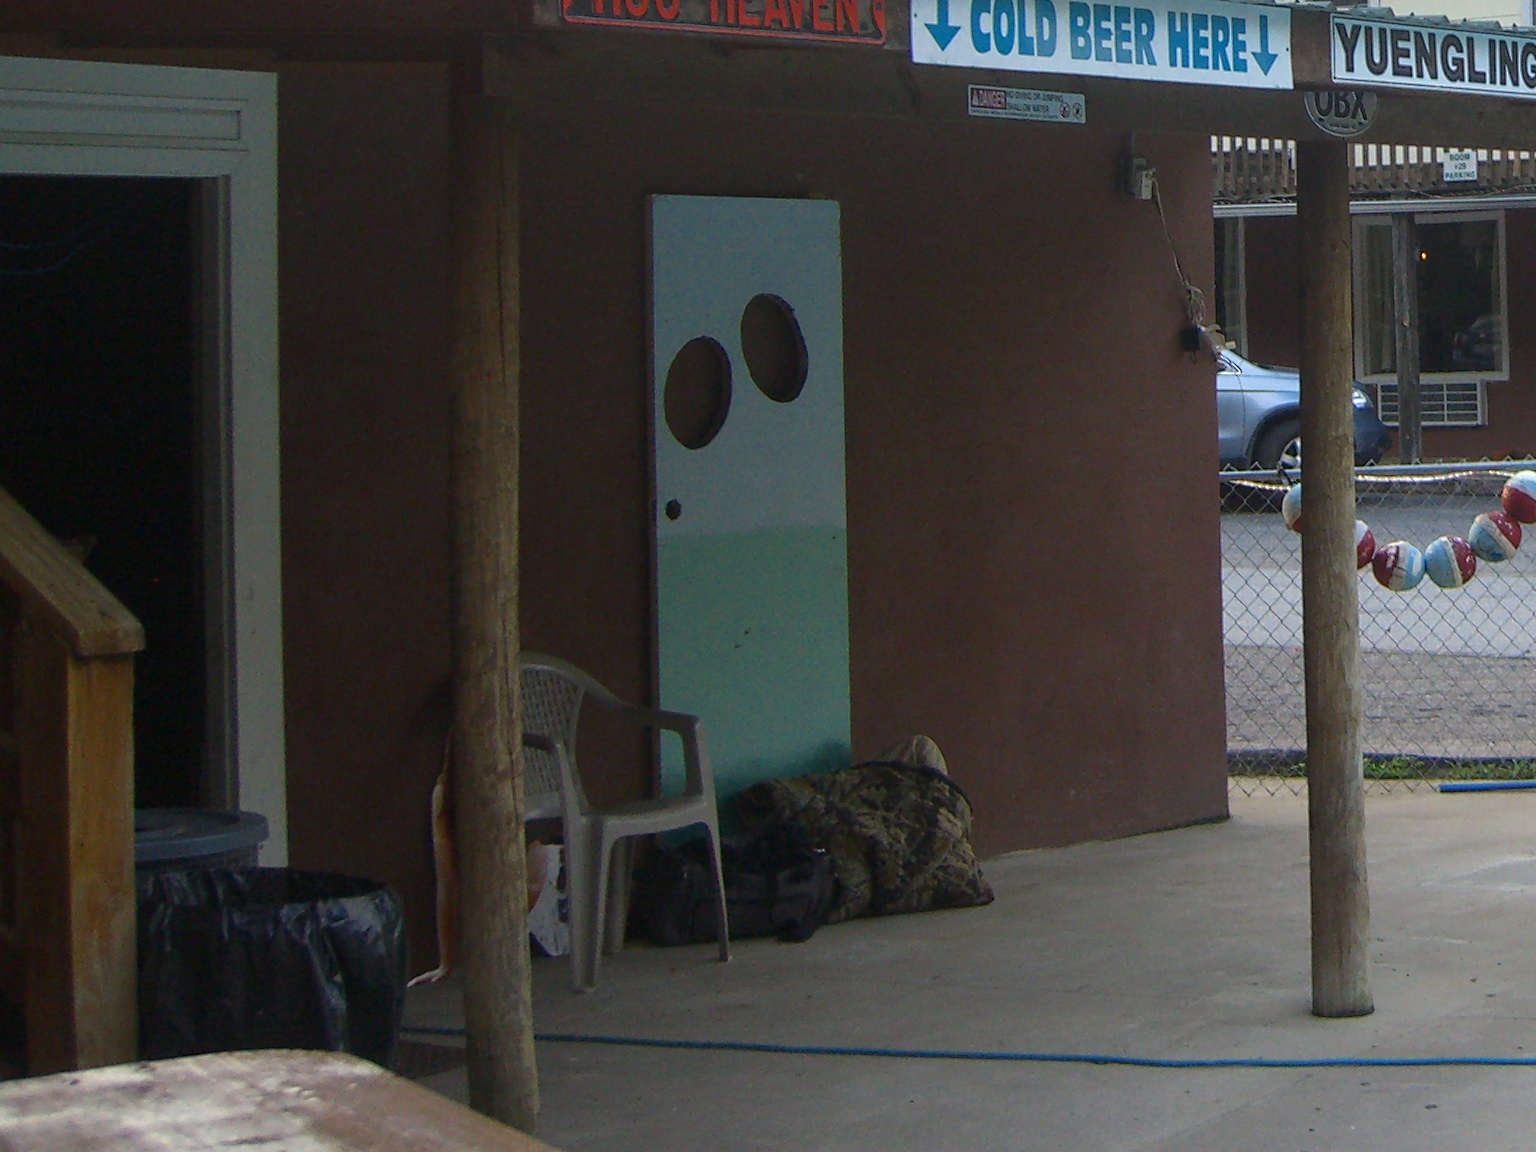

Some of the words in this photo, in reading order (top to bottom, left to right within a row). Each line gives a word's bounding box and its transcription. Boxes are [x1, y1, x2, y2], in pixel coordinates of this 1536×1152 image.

[1069, 0, 1158, 67] BEER
[1167, 10, 1249, 74] HERE
[978, 90, 1006, 109] DANGER
[1449, 152, 1470, 161] ROOM
[1444, 170, 1476, 179] PARKING
